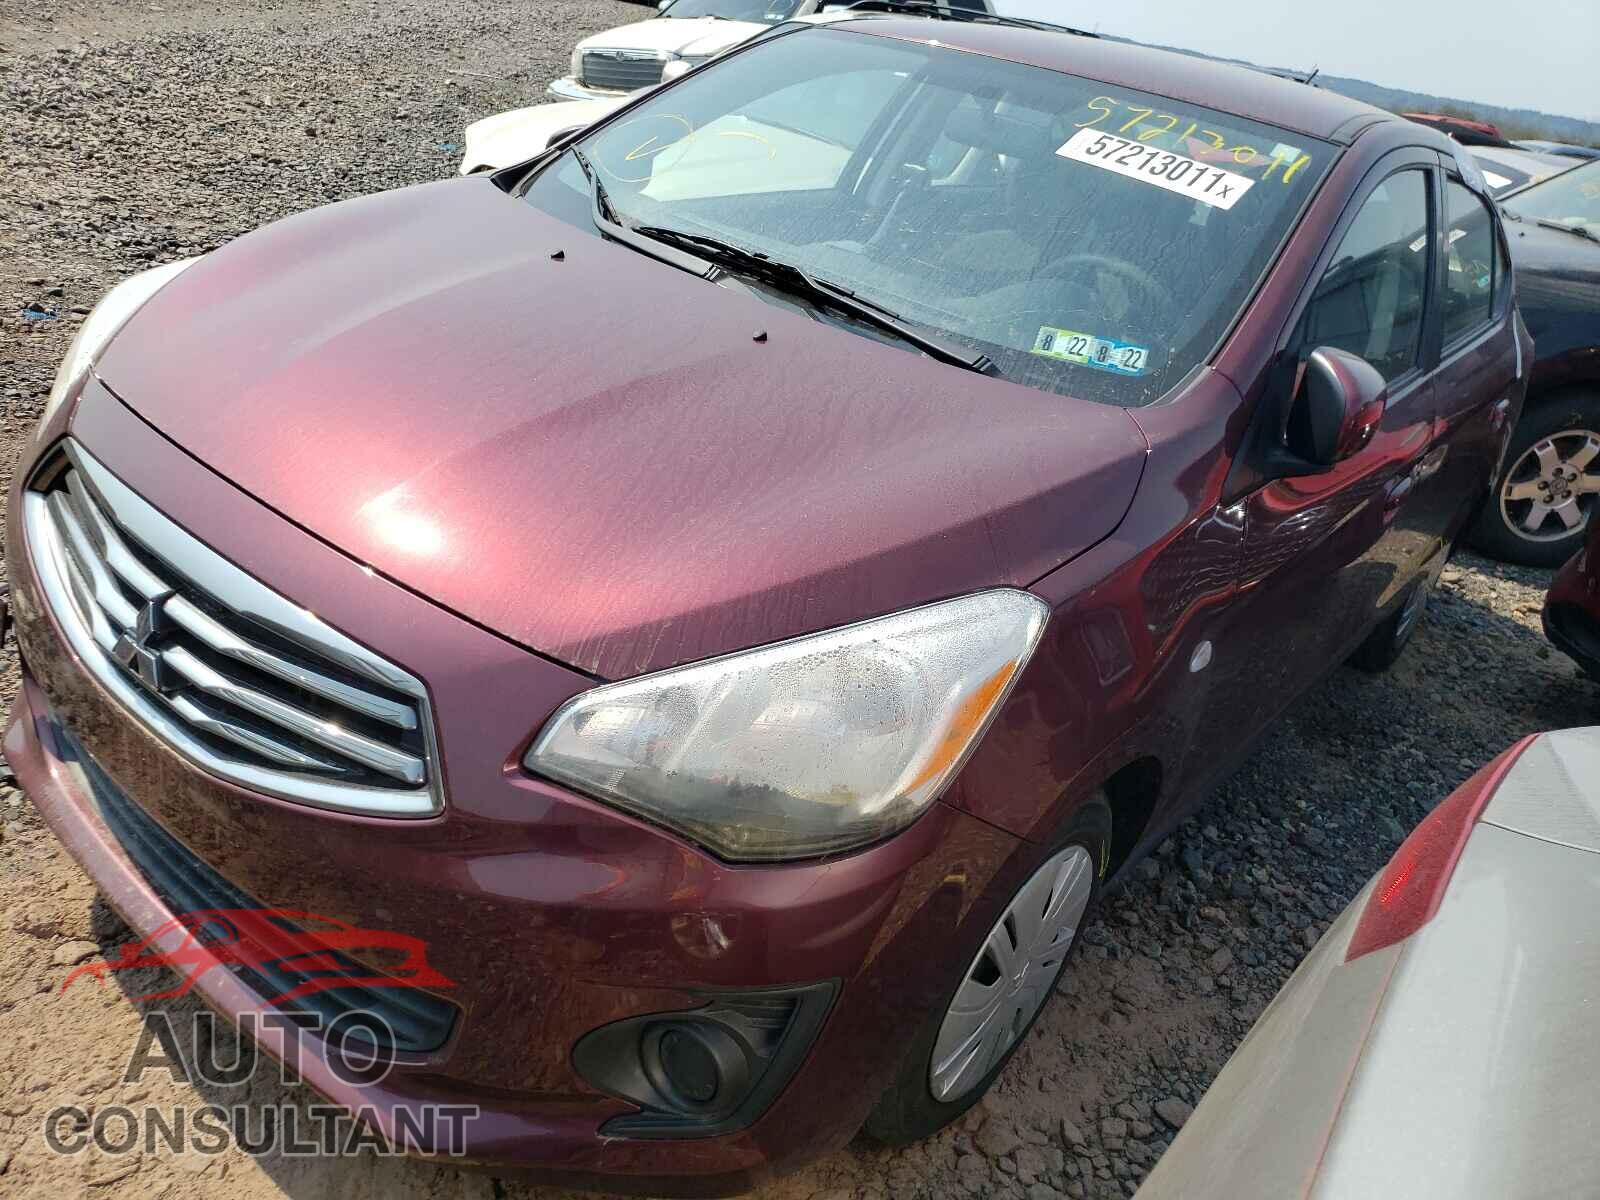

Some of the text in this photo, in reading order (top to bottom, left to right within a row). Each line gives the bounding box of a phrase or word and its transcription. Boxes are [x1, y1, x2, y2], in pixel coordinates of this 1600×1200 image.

[1041, 334, 1087, 356] 8 22
[1097, 346, 1142, 368] 8 22
